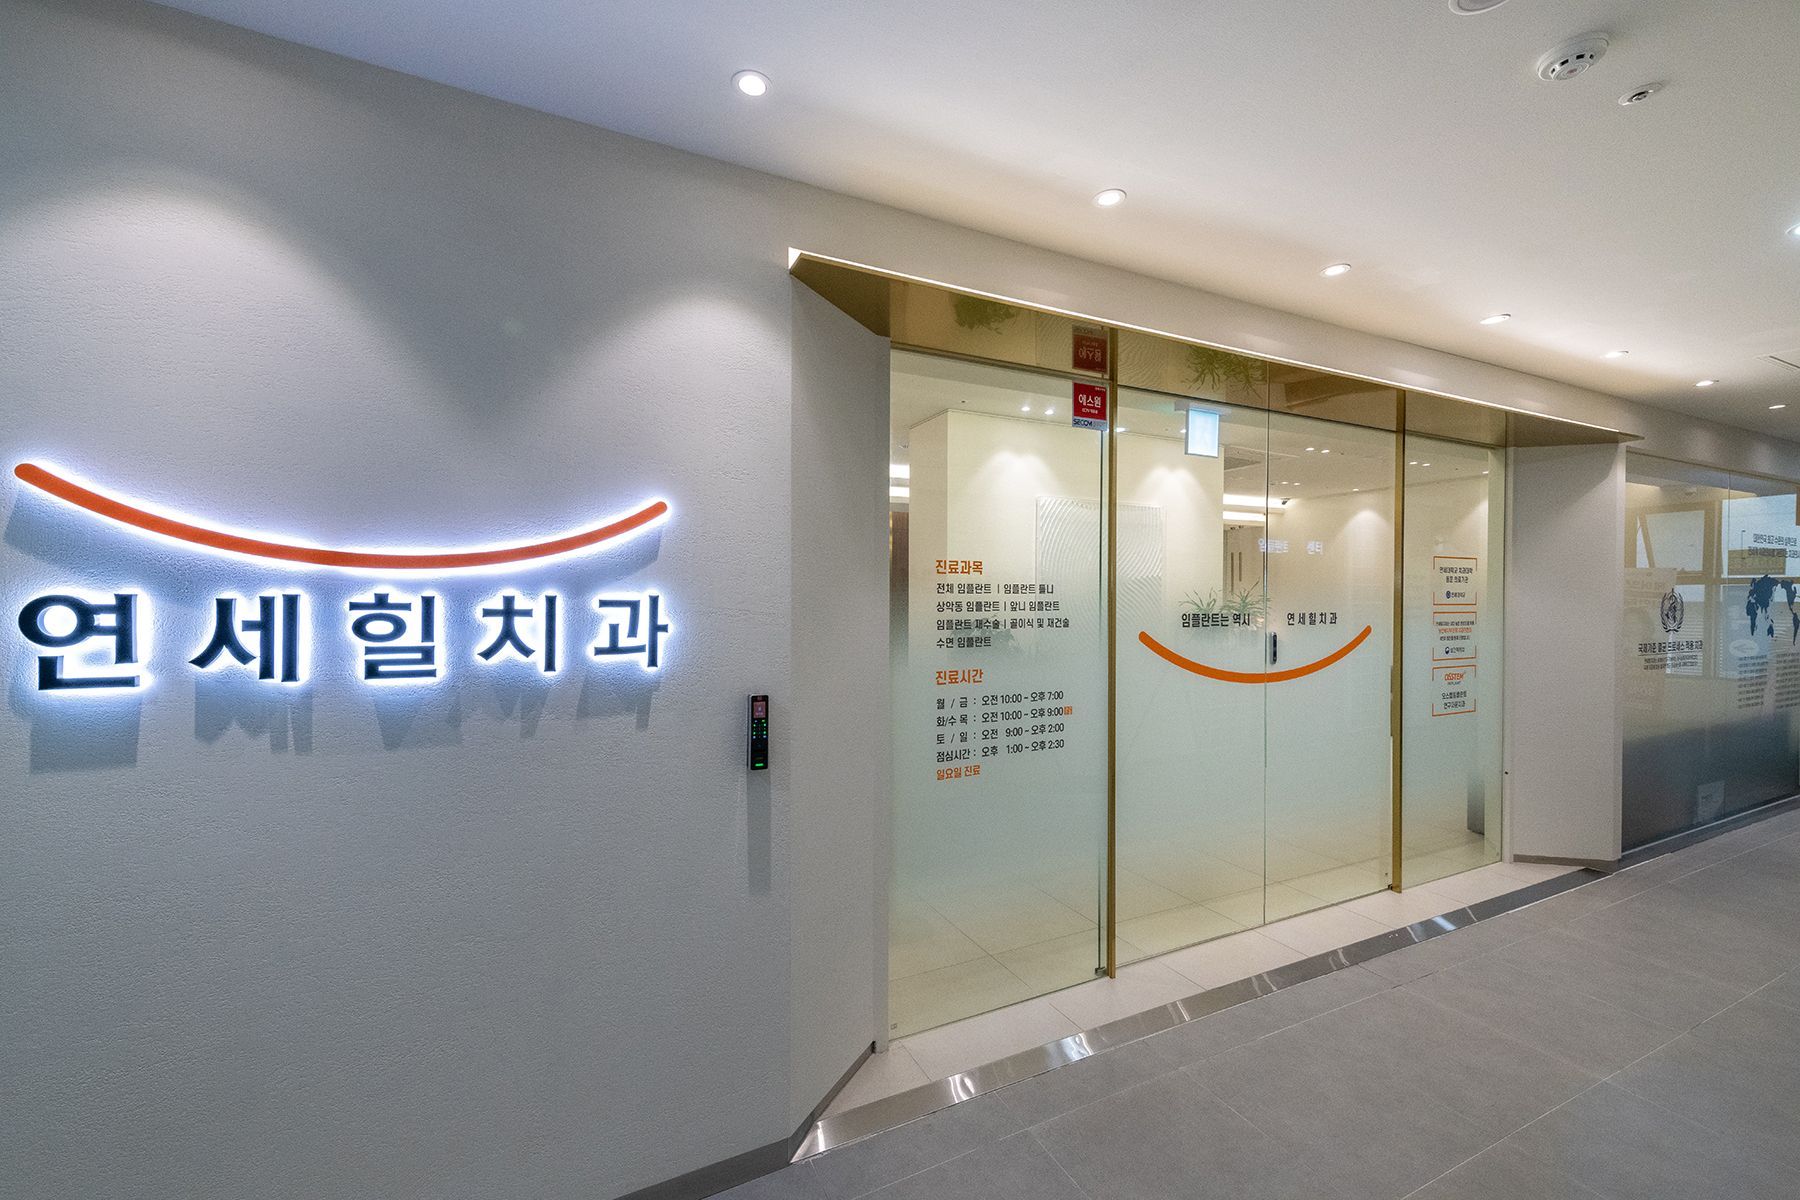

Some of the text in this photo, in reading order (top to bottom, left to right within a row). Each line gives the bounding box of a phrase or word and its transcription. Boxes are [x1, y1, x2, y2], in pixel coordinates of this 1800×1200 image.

[1078, 395, 1101, 408] 에스원
[935, 559, 983, 575] 진료과목
[936, 583, 954, 594] 전체
[958, 583, 992, 594] 임플란트
[1004, 584, 1035, 594] 임플란트
[1039, 584, 1054, 594] 틀니
[936, 602, 963, 613] 상악동
[966, 601, 1000, 612] 임플란트
[1010, 601, 1026, 612] 앞니
[1029, 601, 1060, 611] 임플란트
[936, 619, 972, 631] 임플란트
[975, 618, 1000, 629] 재수술
[1010, 618, 1034, 629] 골이식
[1037, 618, 1044, 629] 및
[1047, 618, 1070, 628] 재건술
[1181, 612, 1337, 628] 임플란트는 역시 연세힐치과
[18, 593, 668, 690] 연세힐치과
[936, 637, 992, 648] 수면 임플란트
[935, 669, 983, 685] 진료시간
[936, 699, 945, 710] 월
[960, 697, 967, 708] 금
[982, 695, 998, 706] 오전
[1001, 694, 1022, 704] 10:00
[1030, 691, 1045, 702] 오후
[1048, 691, 1063, 700] 7:00
[982, 712, 998, 723] 오전
[1001, 710, 1022, 721] 10:00
[1030, 708, 1045, 719] 오후
[1047, 707, 1063, 717] 9:00
[936, 734, 945, 745] 토
[960, 732, 968, 742] 일
[982, 729, 998, 740] 오전
[1005, 727, 1023, 737] 9:00
[1031, 724, 1046, 735] 오후
[1048, 723, 1064, 733] 2:00
[936, 749, 970, 762] 점심시간
[982, 746, 998, 757] 오후
[1006, 744, 1023, 754] 1:00
[1031, 741, 1046, 752] 오후
[1048, 739, 1064, 749] 2:30
[936, 765, 981, 780] 일요일 진료
